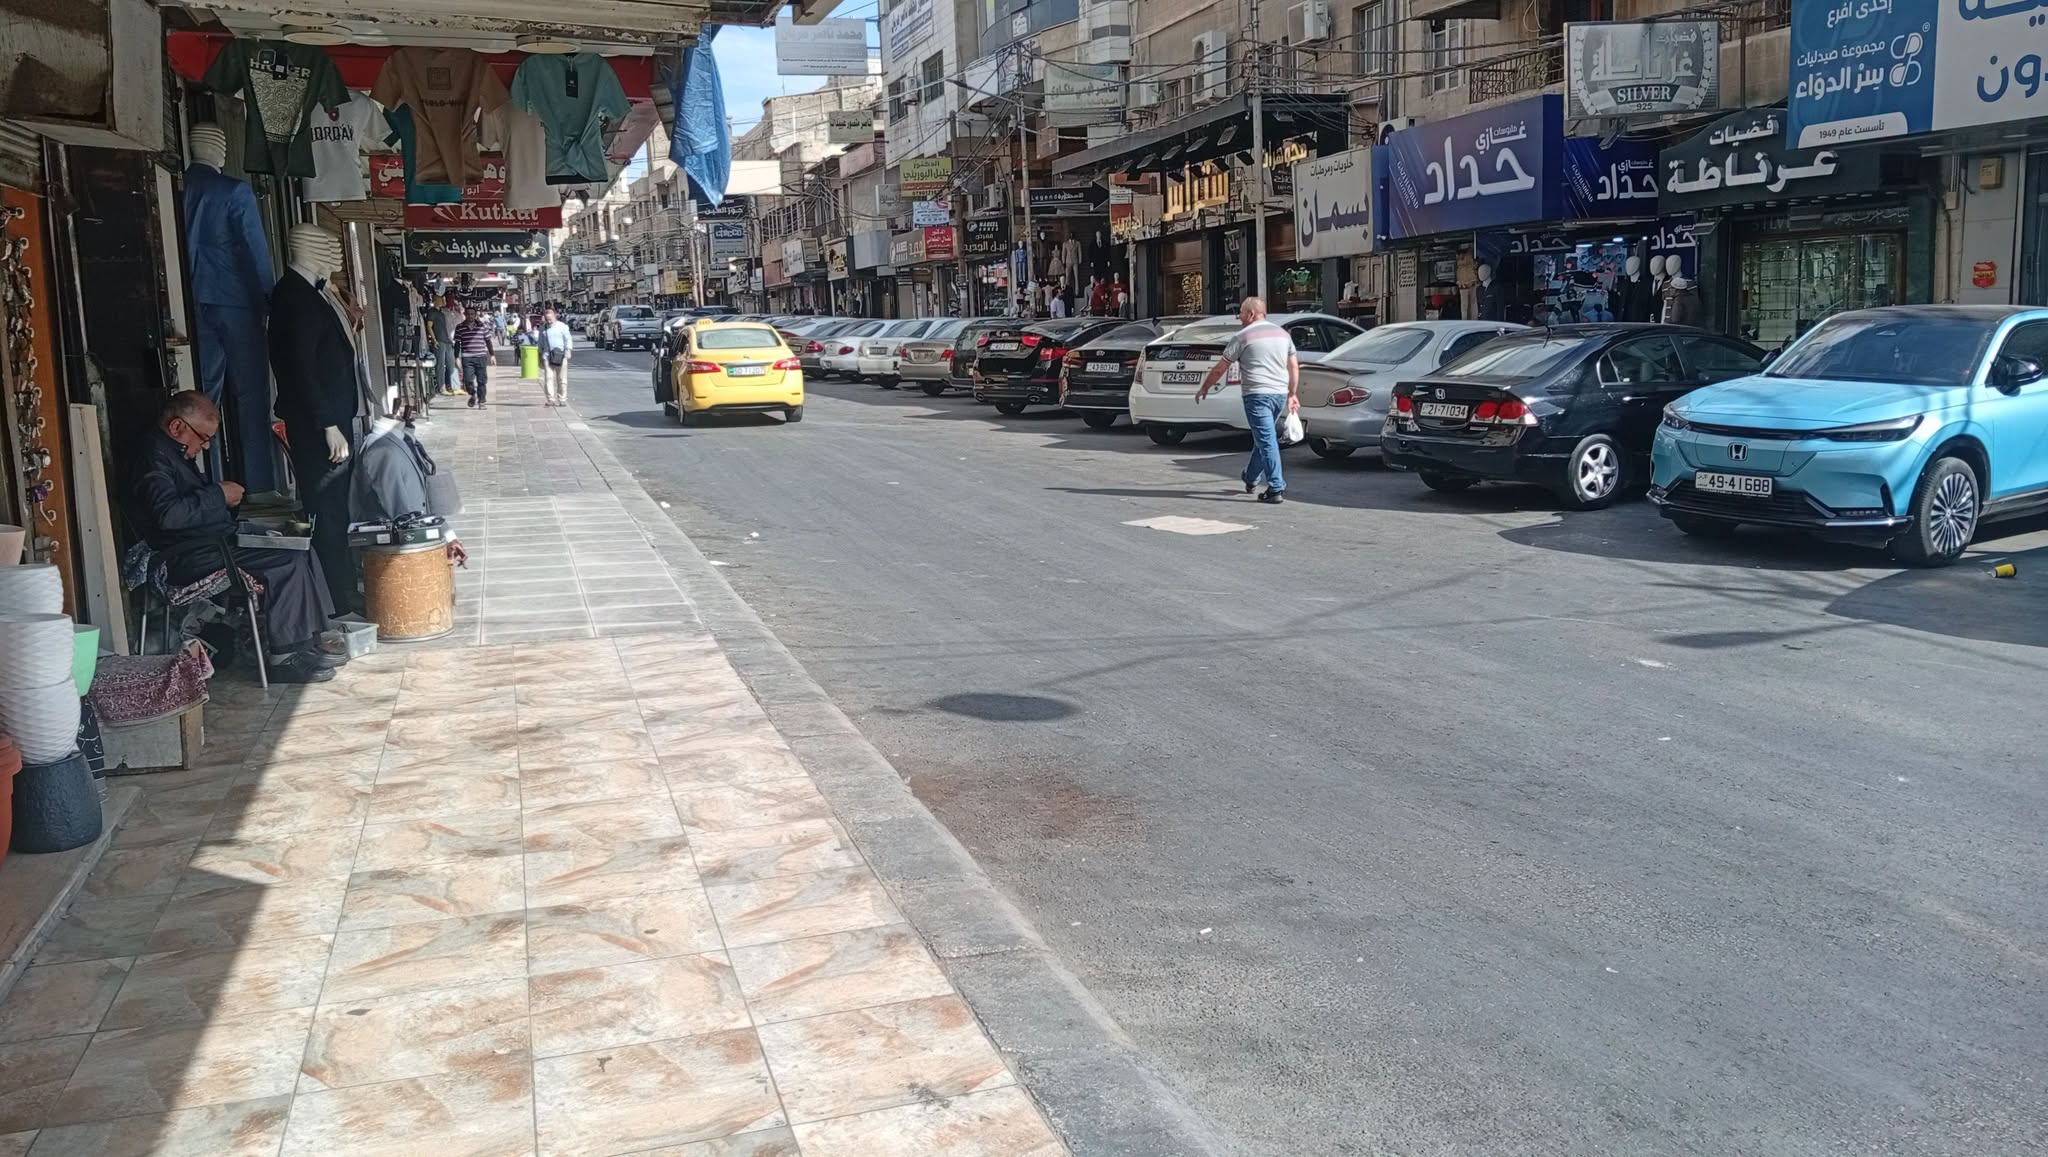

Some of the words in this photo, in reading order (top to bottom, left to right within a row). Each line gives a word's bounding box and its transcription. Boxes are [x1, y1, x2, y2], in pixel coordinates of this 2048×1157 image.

[1797, 48, 1838, 67] صيدليات
[1841, 40, 1886, 59] مجموعة
[1976, 53, 2048, 103] ون
[1617, 85, 1671, 103] SILVER
[1636, 102, 1653, 111] 925
[1709, 114, 1780, 147] فضيات
[1819, 128, 1838, 139] 1949
[1838, 126, 1853, 139] عام
[1854, 121, 1885, 135] تأسست
[1424, 135, 1536, 205] حداد
[1597, 163, 1659, 200] حداد
[1301, 189, 1370, 248] بسمان
[1510, 234, 1571, 253] حداد
